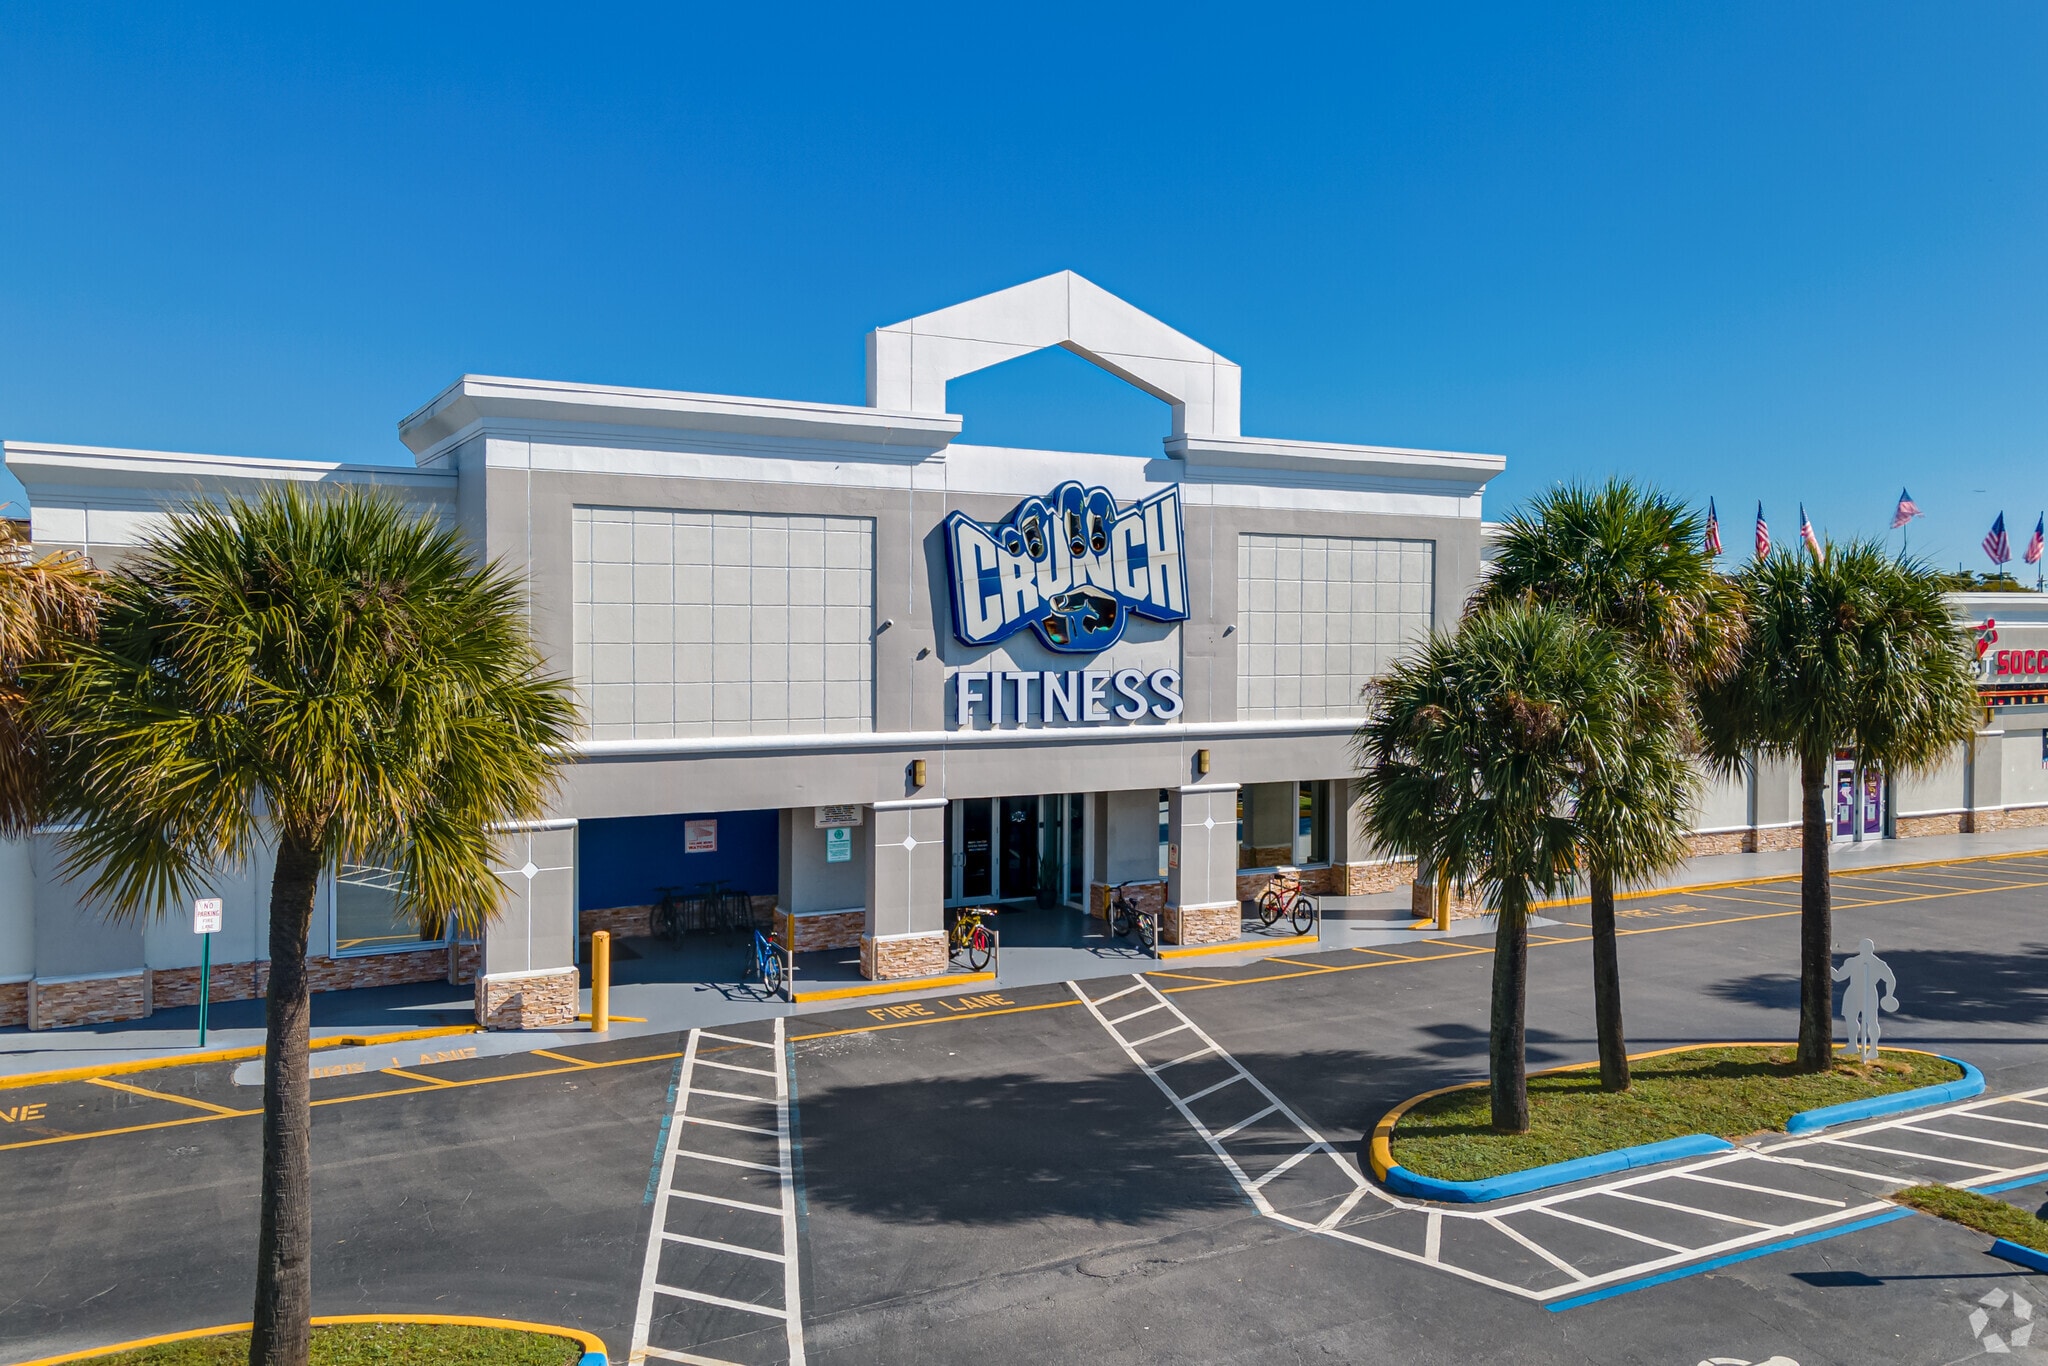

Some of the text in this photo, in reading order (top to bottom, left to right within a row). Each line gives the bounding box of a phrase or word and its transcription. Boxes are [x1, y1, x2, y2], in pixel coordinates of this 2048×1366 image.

[957, 496, 1183, 641] CRUNCH
[956, 668, 1184, 725] FITNESS
[866, 993, 1015, 1021] FIRE LANE
